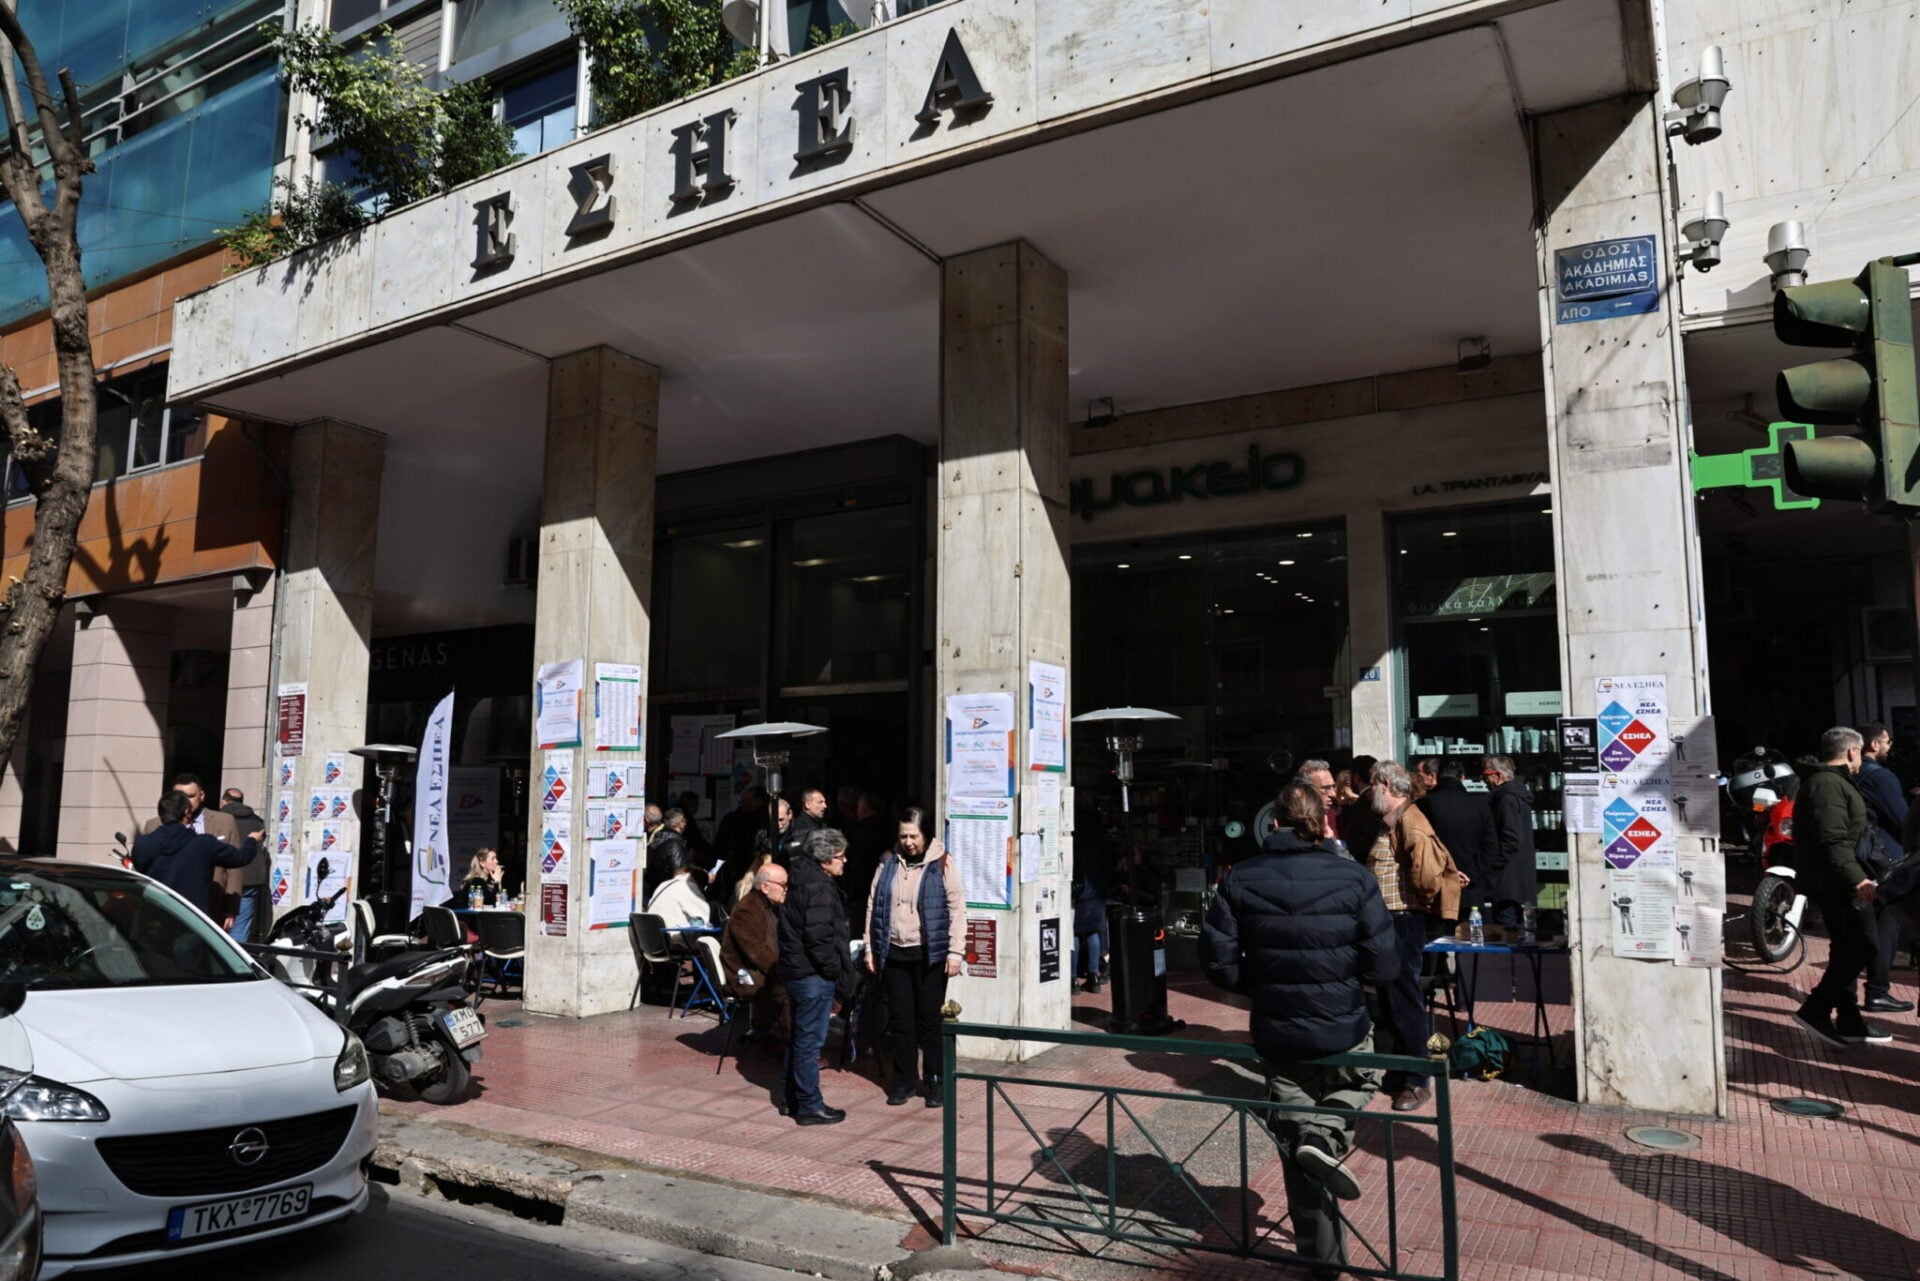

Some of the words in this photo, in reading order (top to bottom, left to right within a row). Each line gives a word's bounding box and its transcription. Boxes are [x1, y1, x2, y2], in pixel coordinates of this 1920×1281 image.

[470, 27, 994, 270] ΕΣΗΕΑ
[1582, 243, 1630, 260] ΟΔΟΣ
[1564, 255, 1648, 279] ΑΚΑΔΗΜΙΑΣ
[1564, 271, 1649, 294] AKADIMIAS
[1561, 305, 1592, 321] ΑΠΟ
[1622, 732, 1651, 740] ΕΣΗΕΑ
[429, 716, 446, 792] ΕΣΗΕΑ
[429, 798, 442, 842] ΝΕΑ
[459, 1020, 481, 1038] 577
